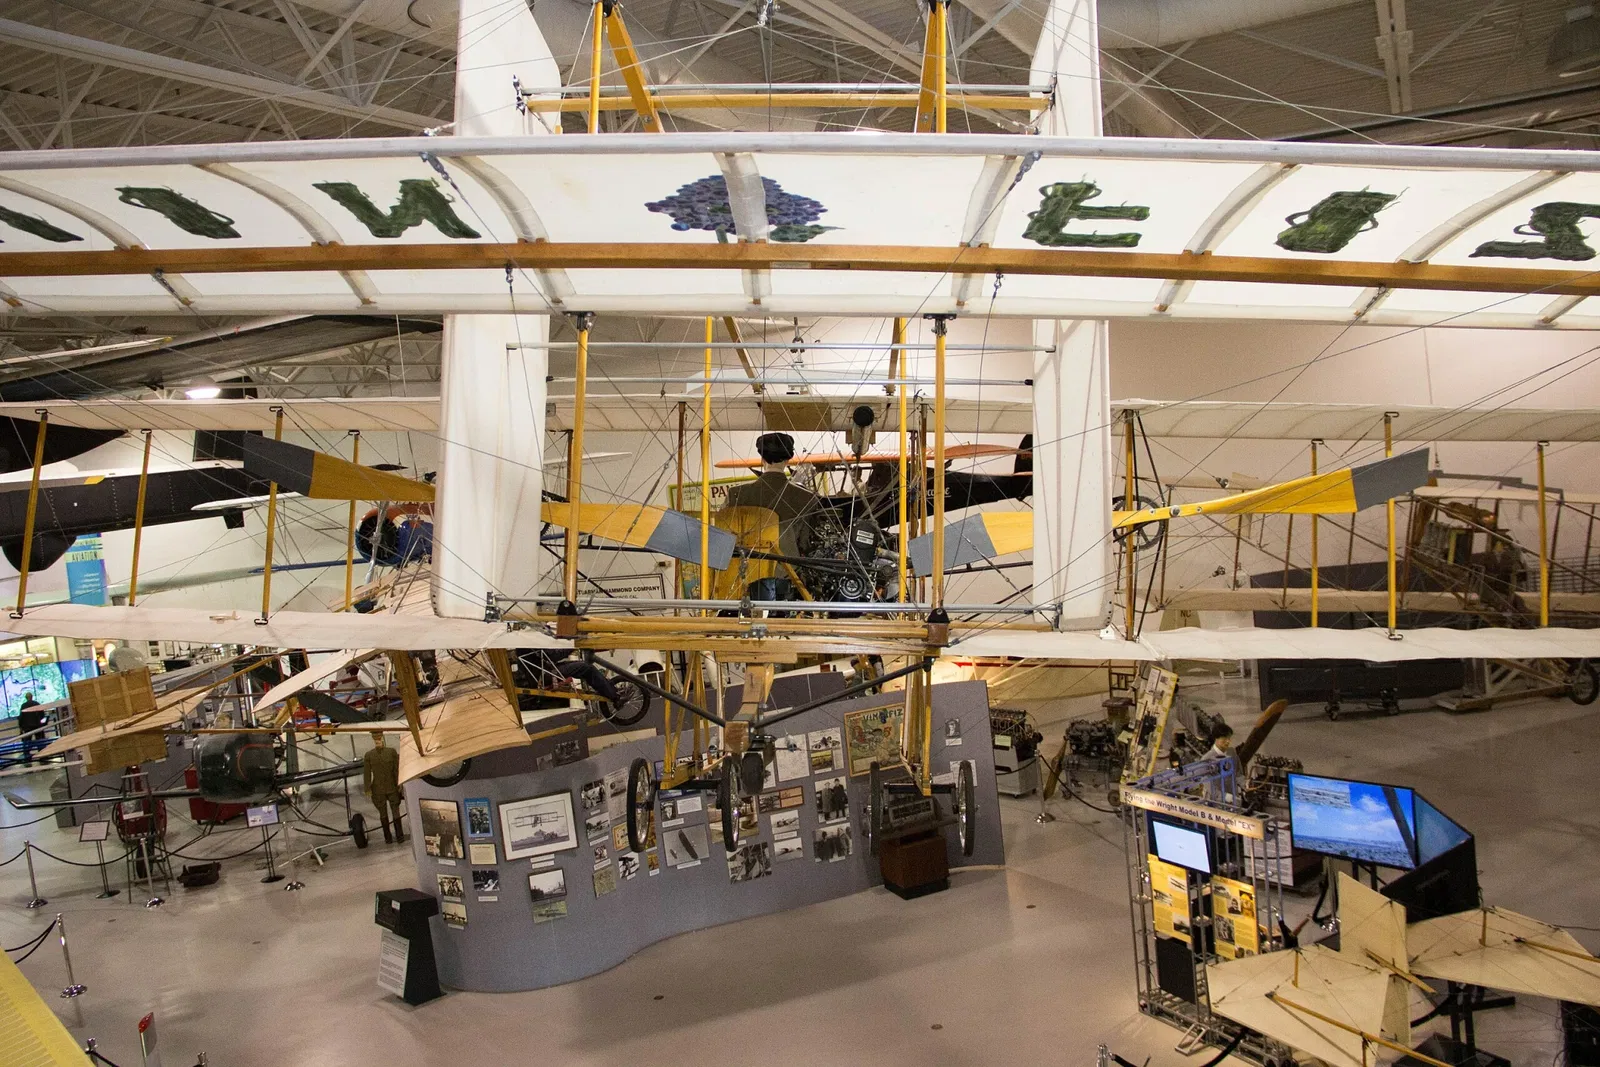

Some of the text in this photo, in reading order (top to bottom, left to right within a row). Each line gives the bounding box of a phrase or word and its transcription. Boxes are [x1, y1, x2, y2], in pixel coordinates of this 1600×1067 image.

[888, 708, 903, 718] FIZ
[1124, 791, 1144, 804] Flying
[1144, 798, 1155, 806] the
[1156, 800, 1178, 812] Wright
[1178, 805, 1199, 817] Model
[1200, 811, 1206, 819] B
[1208, 813, 1213, 821] &
[1215, 815, 1237, 827] Model
